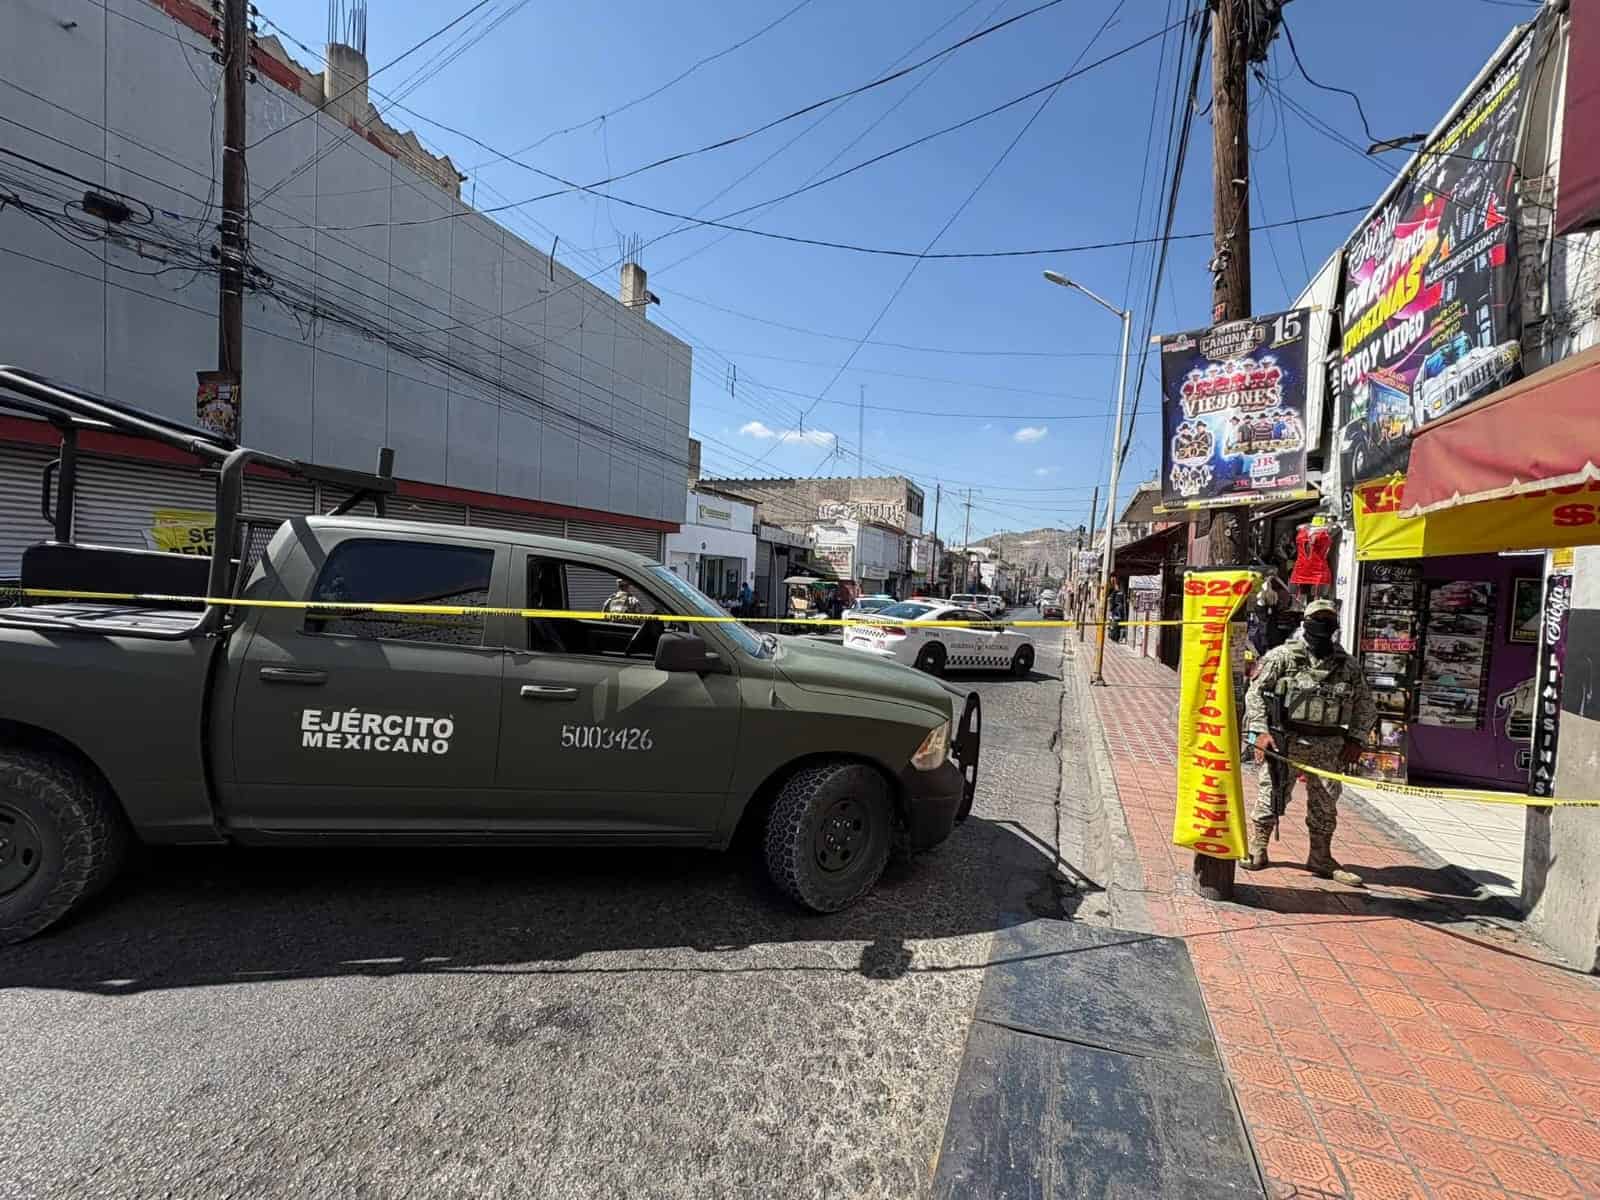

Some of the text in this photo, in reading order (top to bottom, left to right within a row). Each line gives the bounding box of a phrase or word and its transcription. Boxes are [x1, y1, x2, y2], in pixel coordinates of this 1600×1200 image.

[1272, 312, 1302, 343] 15
[1383, 310, 1424, 360] VIDEO
[1184, 388, 1280, 418] VIEJONES
[301, 708, 454, 738] EJÉRCITO
[561, 724, 653, 750] 5003426
[1535, 653, 1559, 794] LIMUSINAS
[302, 731, 449, 755] MEXICANO
